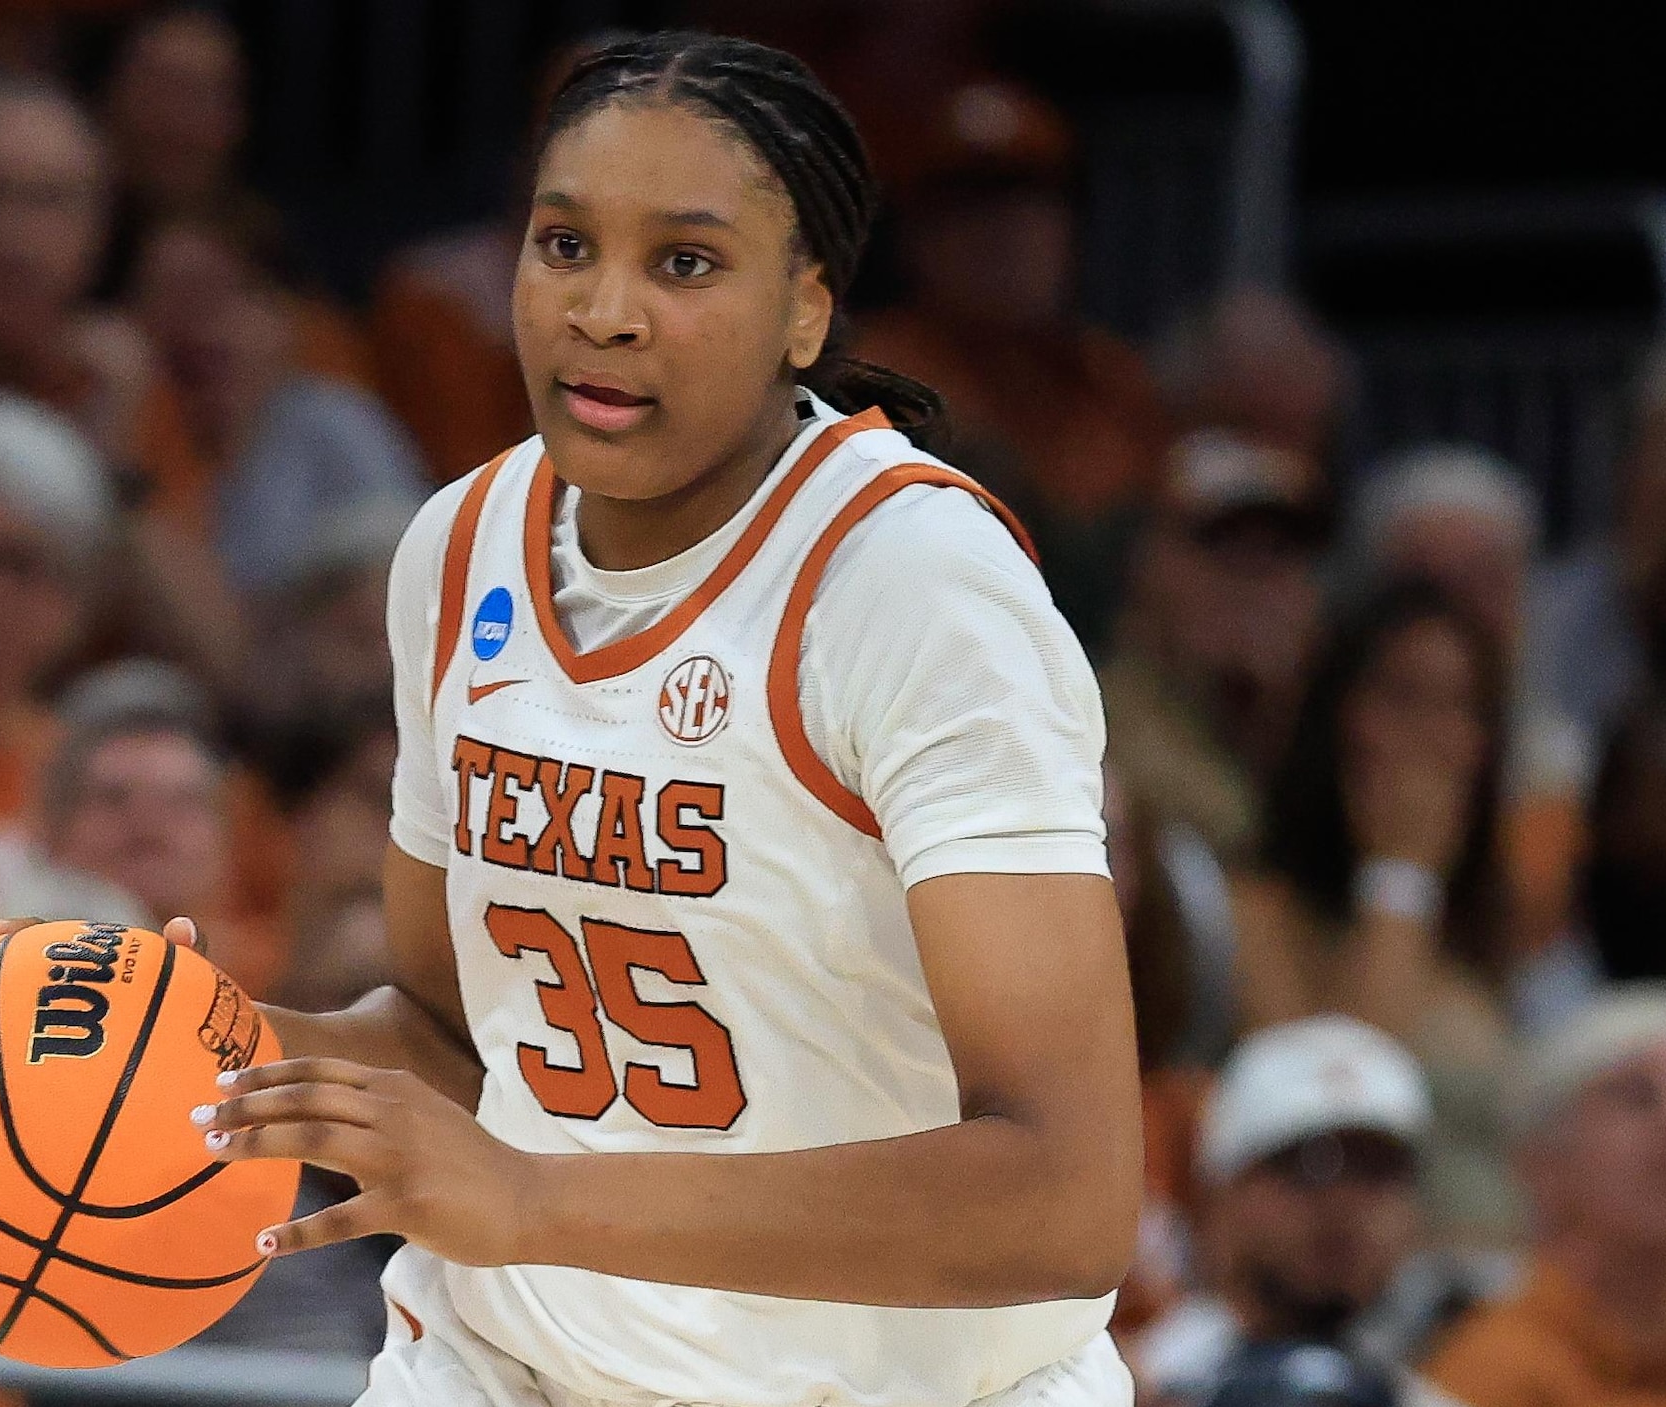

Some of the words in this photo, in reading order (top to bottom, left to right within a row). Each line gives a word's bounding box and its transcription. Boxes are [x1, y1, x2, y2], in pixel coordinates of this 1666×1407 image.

[660, 659, 728, 738] SEC
[452, 734, 728, 897] TEXAS
[28, 921, 129, 1064] Wils
[484, 901, 748, 1131] 35
